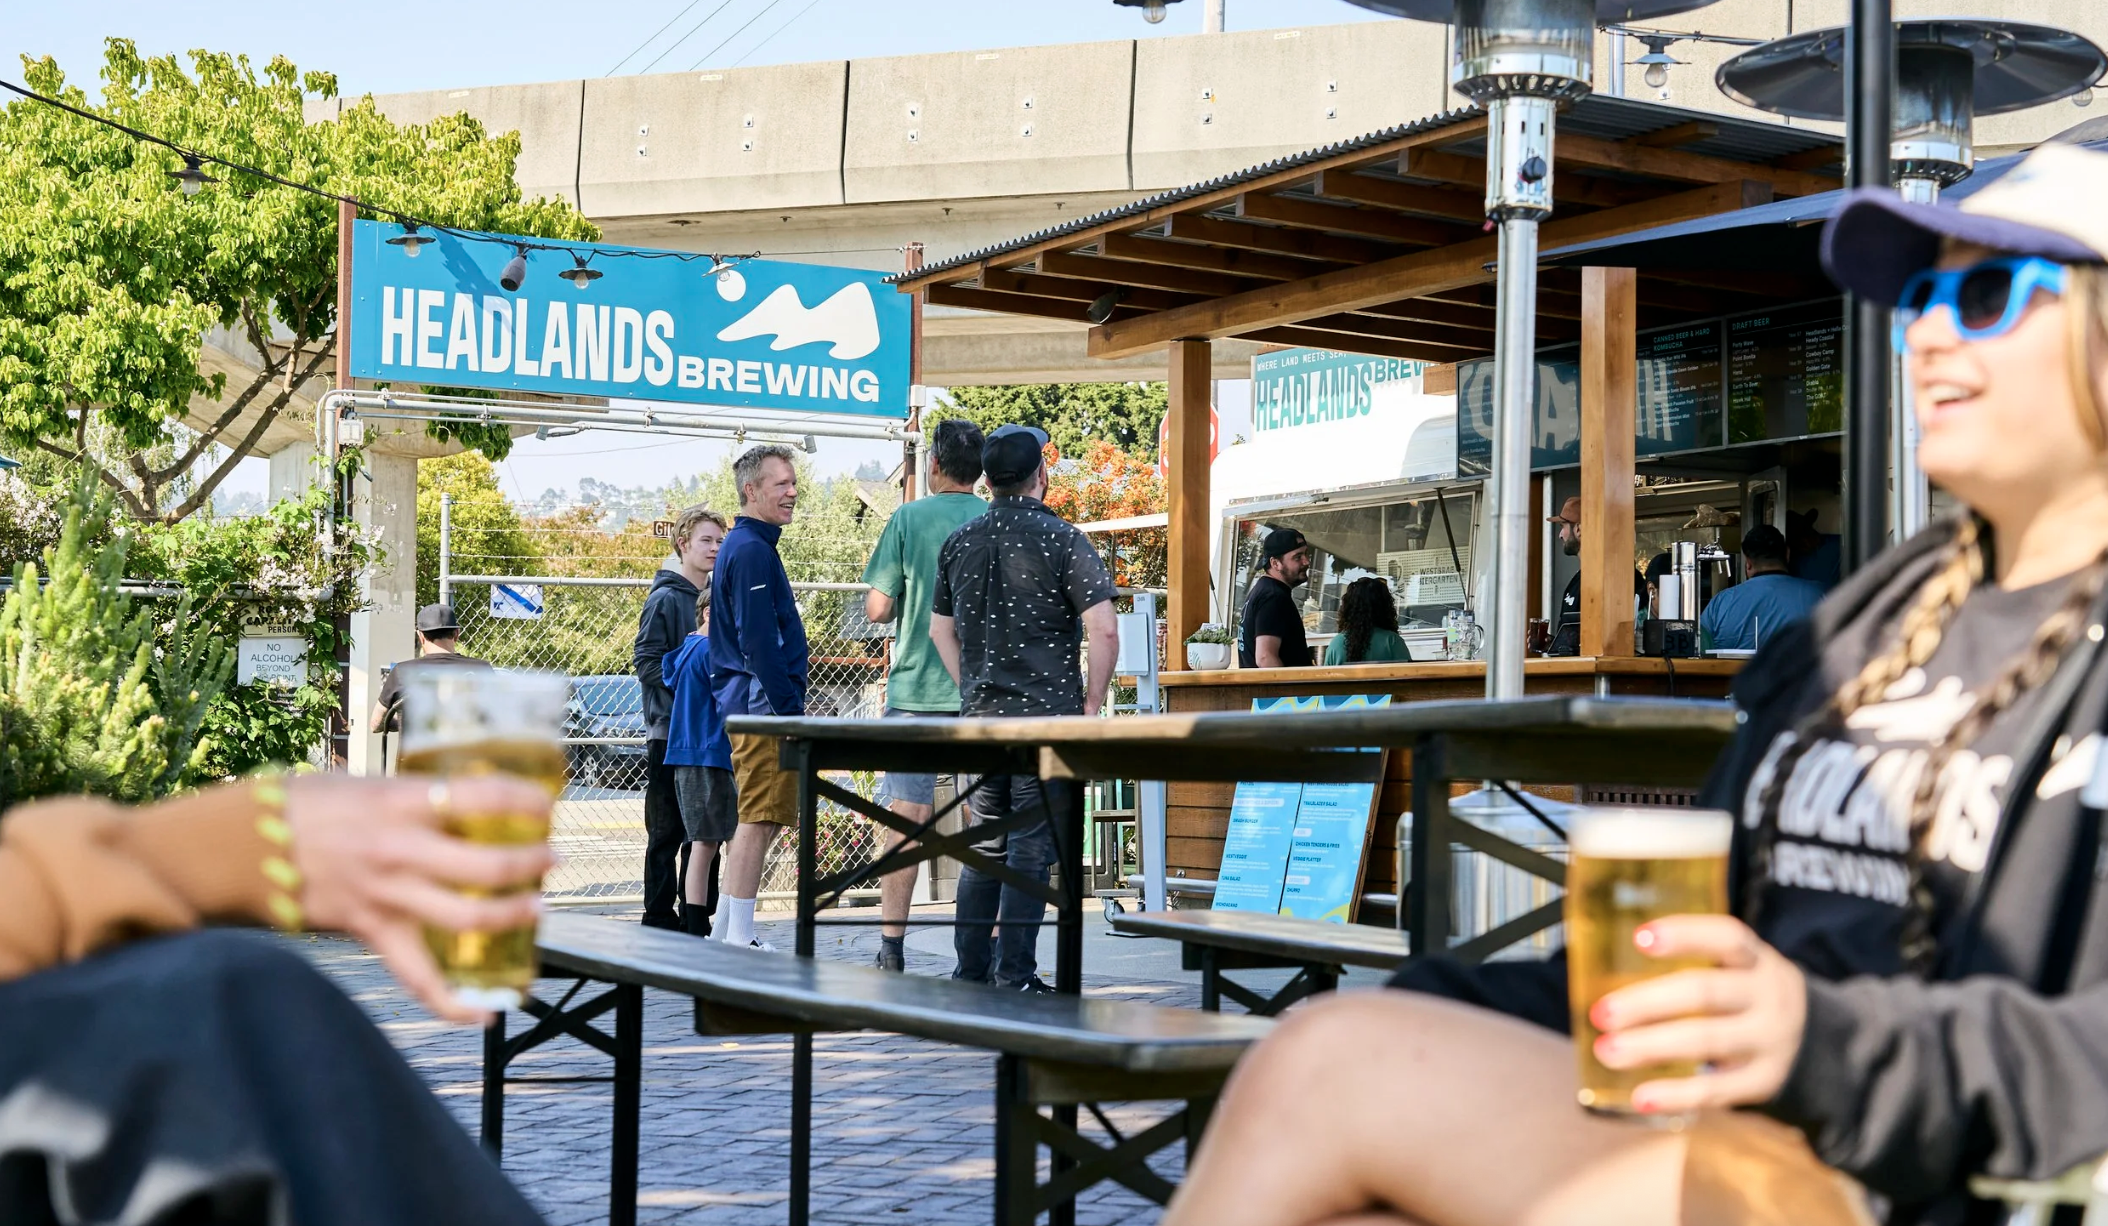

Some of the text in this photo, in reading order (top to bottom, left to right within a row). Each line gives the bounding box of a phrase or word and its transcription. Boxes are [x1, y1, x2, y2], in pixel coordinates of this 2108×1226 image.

[1732, 318, 1770, 330] DRAFT BEER
[1654, 334, 1674, 343] CANNED
[1675, 331, 1689, 339] BEER
[1695, 328, 1710, 336] HARD
[381, 286, 880, 403] HEADLANDS BREWING
[1653, 341, 1683, 351] KOMBUCHA
[1257, 359, 1278, 372] WHERE
[1281, 356, 1299, 367] LAND
[1302, 351, 1325, 363] MEETS
[1255, 363, 1372, 432] HEADLANDS
[656, 522, 674, 536] Gil
[266, 643, 281, 652] NO
[250, 653, 297, 663] ALCOHOL
[256, 664, 291, 672] BEYOND
